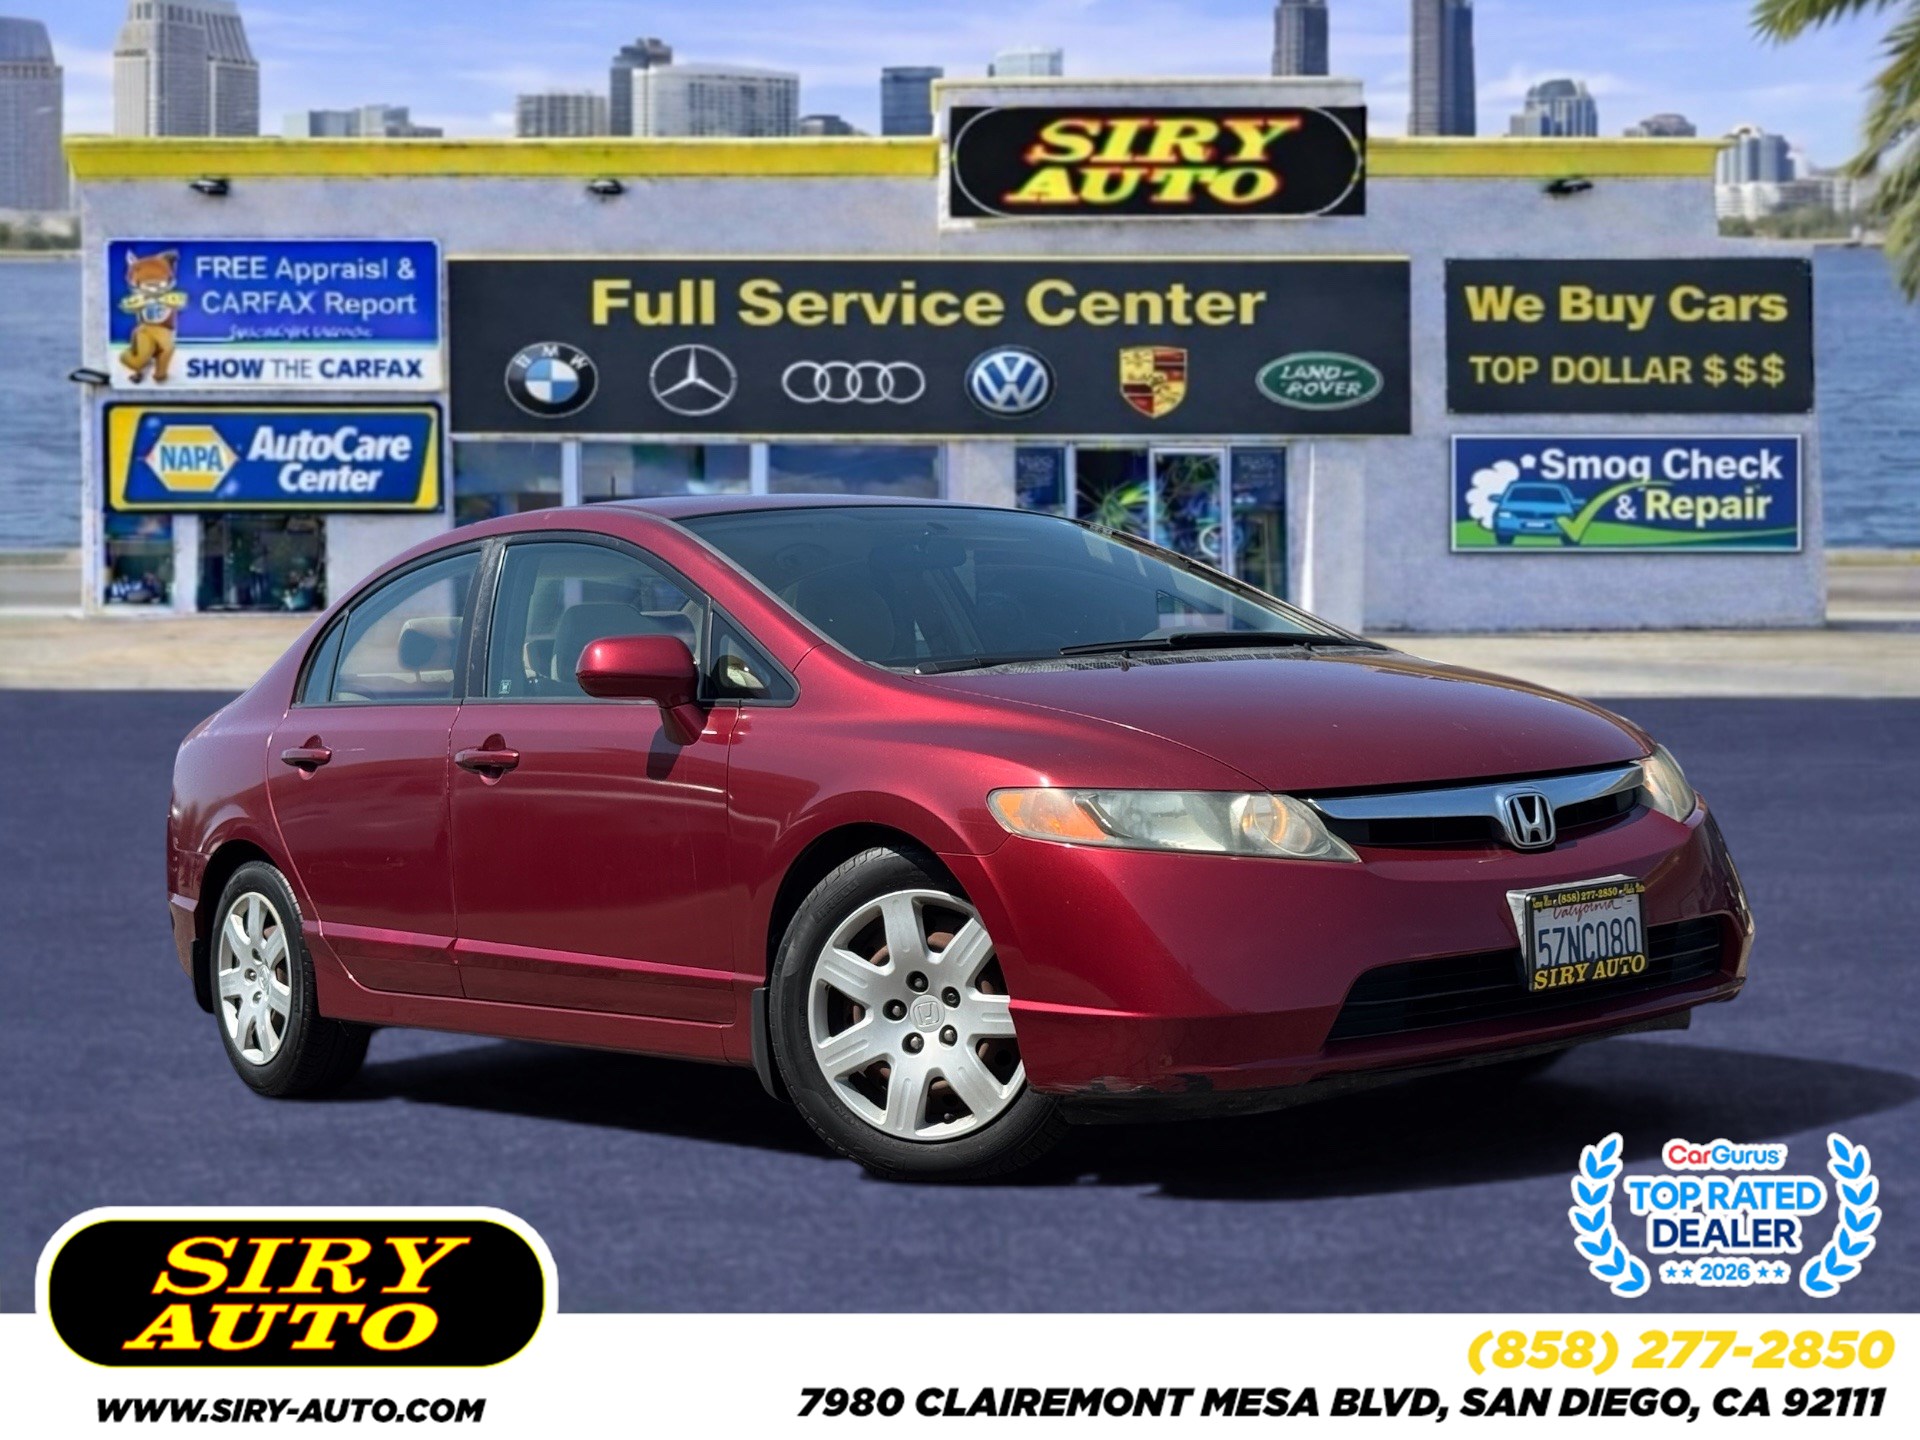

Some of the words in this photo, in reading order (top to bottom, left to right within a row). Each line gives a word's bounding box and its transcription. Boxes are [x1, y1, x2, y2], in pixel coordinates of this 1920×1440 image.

[1024, 117, 1301, 163] SIRY
[1003, 166, 1279, 204] AUTO
[196, 256, 267, 279] FREE
[275, 257, 388, 285] Appraisl
[397, 257, 416, 280] &
[202, 290, 315, 315] CARFAX
[325, 291, 417, 321] Report
[592, 279, 716, 326] Full
[738, 279, 1005, 327] Service
[1026, 279, 1267, 327] Center
[1465, 286, 1545, 323] We
[1559, 285, 1655, 331] Buy
[1668, 285, 1789, 323] Cars
[186, 358, 265, 379] SHOW
[271, 359, 312, 379] THE
[318, 358, 424, 379] CARFAX
[1469, 356, 1539, 384] TOP
[1551, 356, 1693, 385] DOLLAR
[160, 445, 225, 472] NAPA
[247, 426, 413, 462] AutoCare
[278, 462, 383, 493] Center
[1541, 448, 1652, 484] Smog
[1662, 448, 1784, 480] Check
[1614, 495, 1637, 521] &
[1645, 487, 1773, 528] Repair
[1553, 901, 1622, 922] California
[1558, 891, 1580, 905] (858)
[1533, 963, 1589, 991] SIRY
[1592, 954, 1646, 980] AUTO
